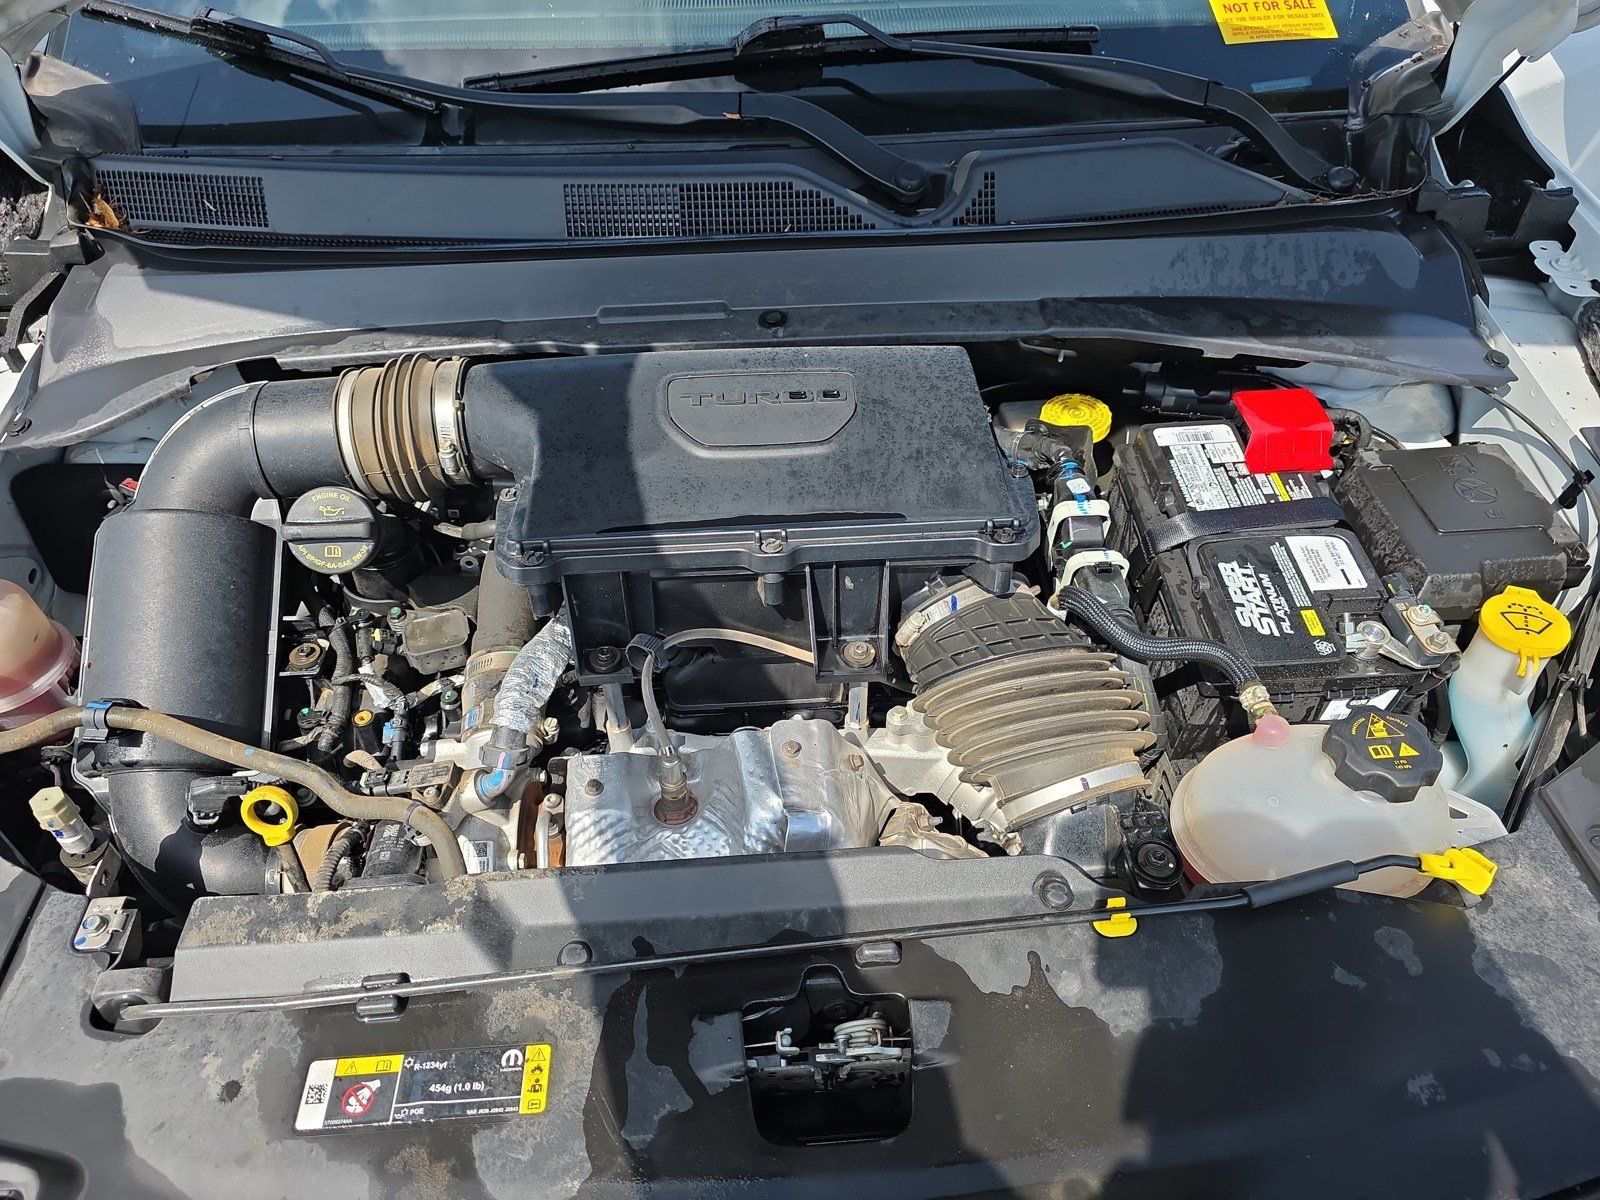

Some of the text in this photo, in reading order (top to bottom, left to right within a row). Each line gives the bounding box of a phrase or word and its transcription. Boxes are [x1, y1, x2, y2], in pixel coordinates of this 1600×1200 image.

[1222, 0, 1317, 14] NOT FOR SALE
[680, 389, 848, 407] TURBO
[311, 491, 351, 503] ENGINE OIL
[298, 544, 307, 555] API
[1217, 560, 1252, 628] SUPER
[1239, 567, 1281, 637] START
[1258, 573, 1295, 635] PLATINUM
[413, 1060, 448, 1071] R-1234yf
[429, 1080, 485, 1094] 454g (1.0 lb)
[409, 1107, 425, 1115] POE
